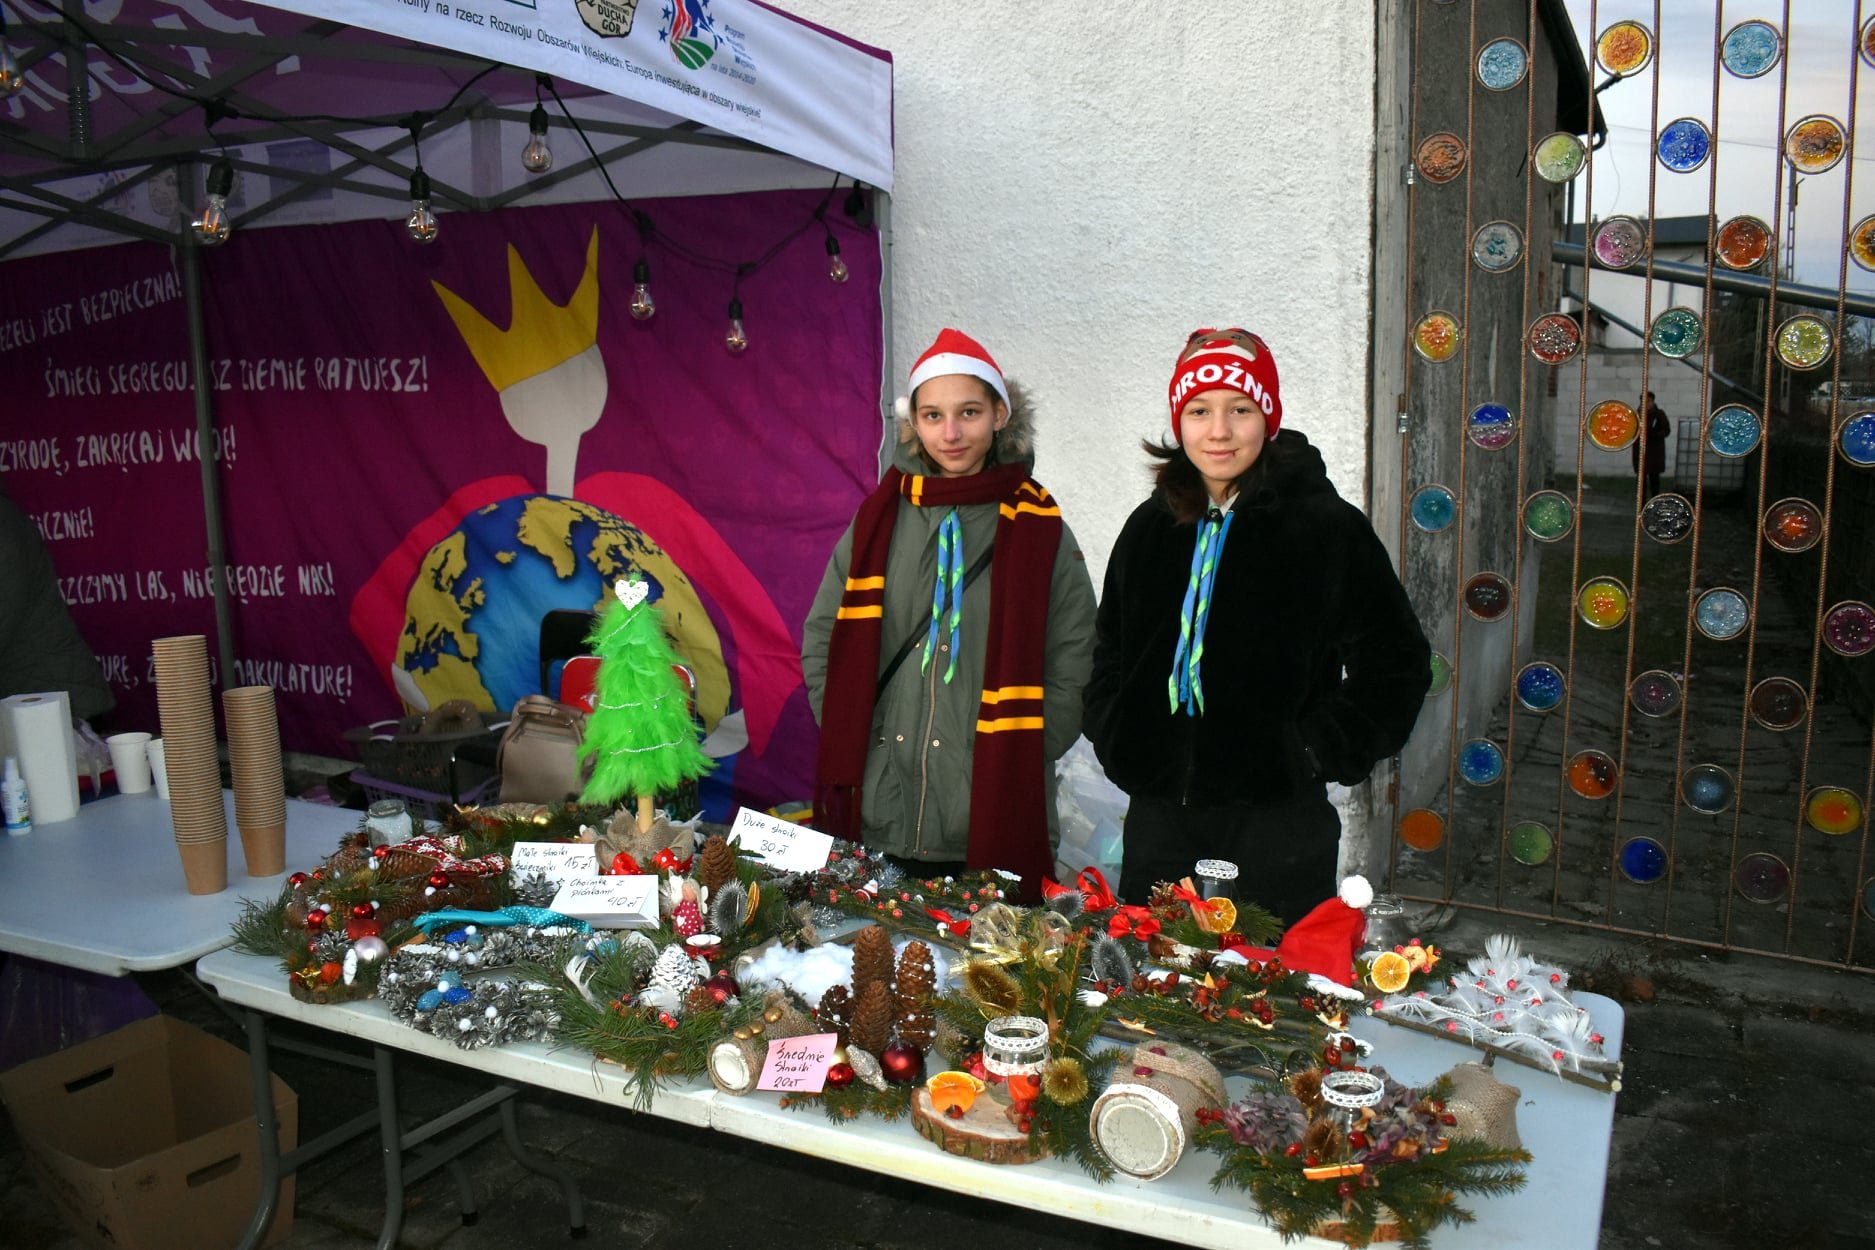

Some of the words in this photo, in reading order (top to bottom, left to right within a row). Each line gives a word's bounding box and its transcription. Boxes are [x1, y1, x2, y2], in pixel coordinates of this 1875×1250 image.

[597, 4, 628, 26] DUCHA
[436, 2, 449, 16] na
[455, 8, 484, 26] rzecz
[490, 15, 532, 40] Rozwoju
[537, 28, 580, 53] Obszarów
[624, 59, 653, 80] Europa
[654, 70, 700, 96] inwestująca
[42, 303, 73, 338] JEST
[81, 271, 183, 326] BEZPIECZNA!
[109, 357, 233, 396] SEGREGUSZ
[314, 355, 428, 393] RATUJESZ!
[76, 429, 164, 474] ZAKRĘCAJ
[30, 507, 94, 541] ICZNIE!
[136, 569, 176, 603] LAS,
[183, 566, 215, 599] NIE
[298, 561, 336, 597] NAS!
[743, 812, 766, 829] Duże
[518, 847, 538, 858] Małe
[760, 839, 776, 853] 30
[564, 855, 585, 870] 15
[607, 896, 628, 907] 40
